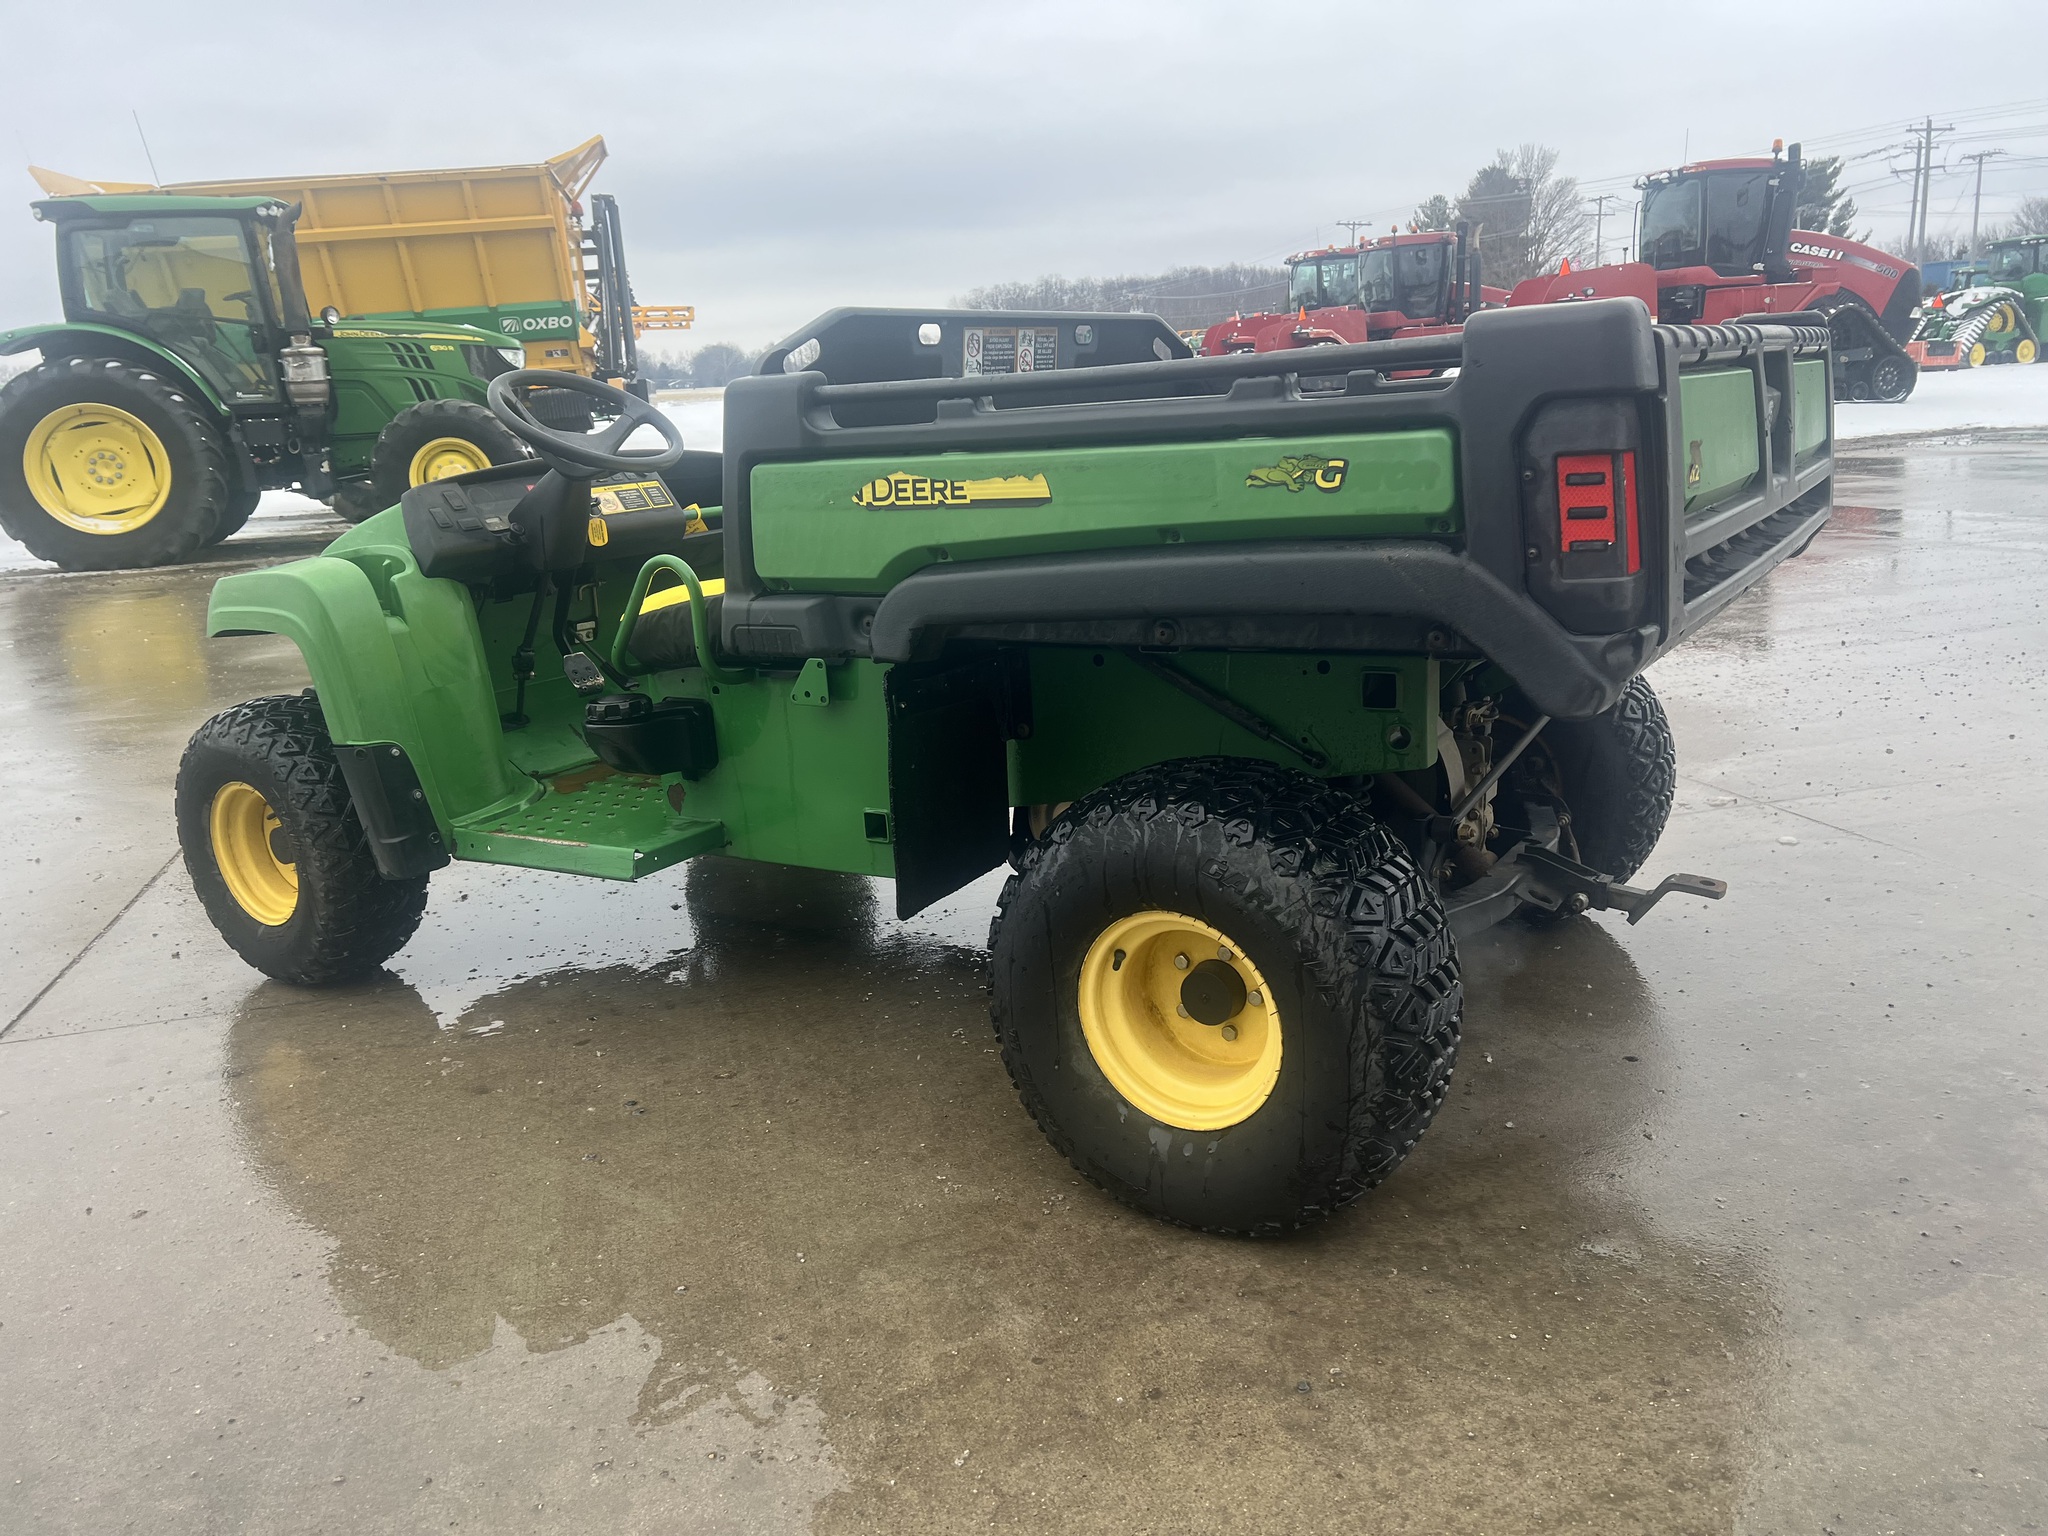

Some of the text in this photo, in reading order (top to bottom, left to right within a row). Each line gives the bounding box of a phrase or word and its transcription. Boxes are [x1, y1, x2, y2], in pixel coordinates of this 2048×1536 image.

[1790, 242, 1830, 258] CASE
[1874, 263, 1899, 279] 500
[523, 316, 573, 331] OXBO
[871, 476, 968, 503] DEERE
